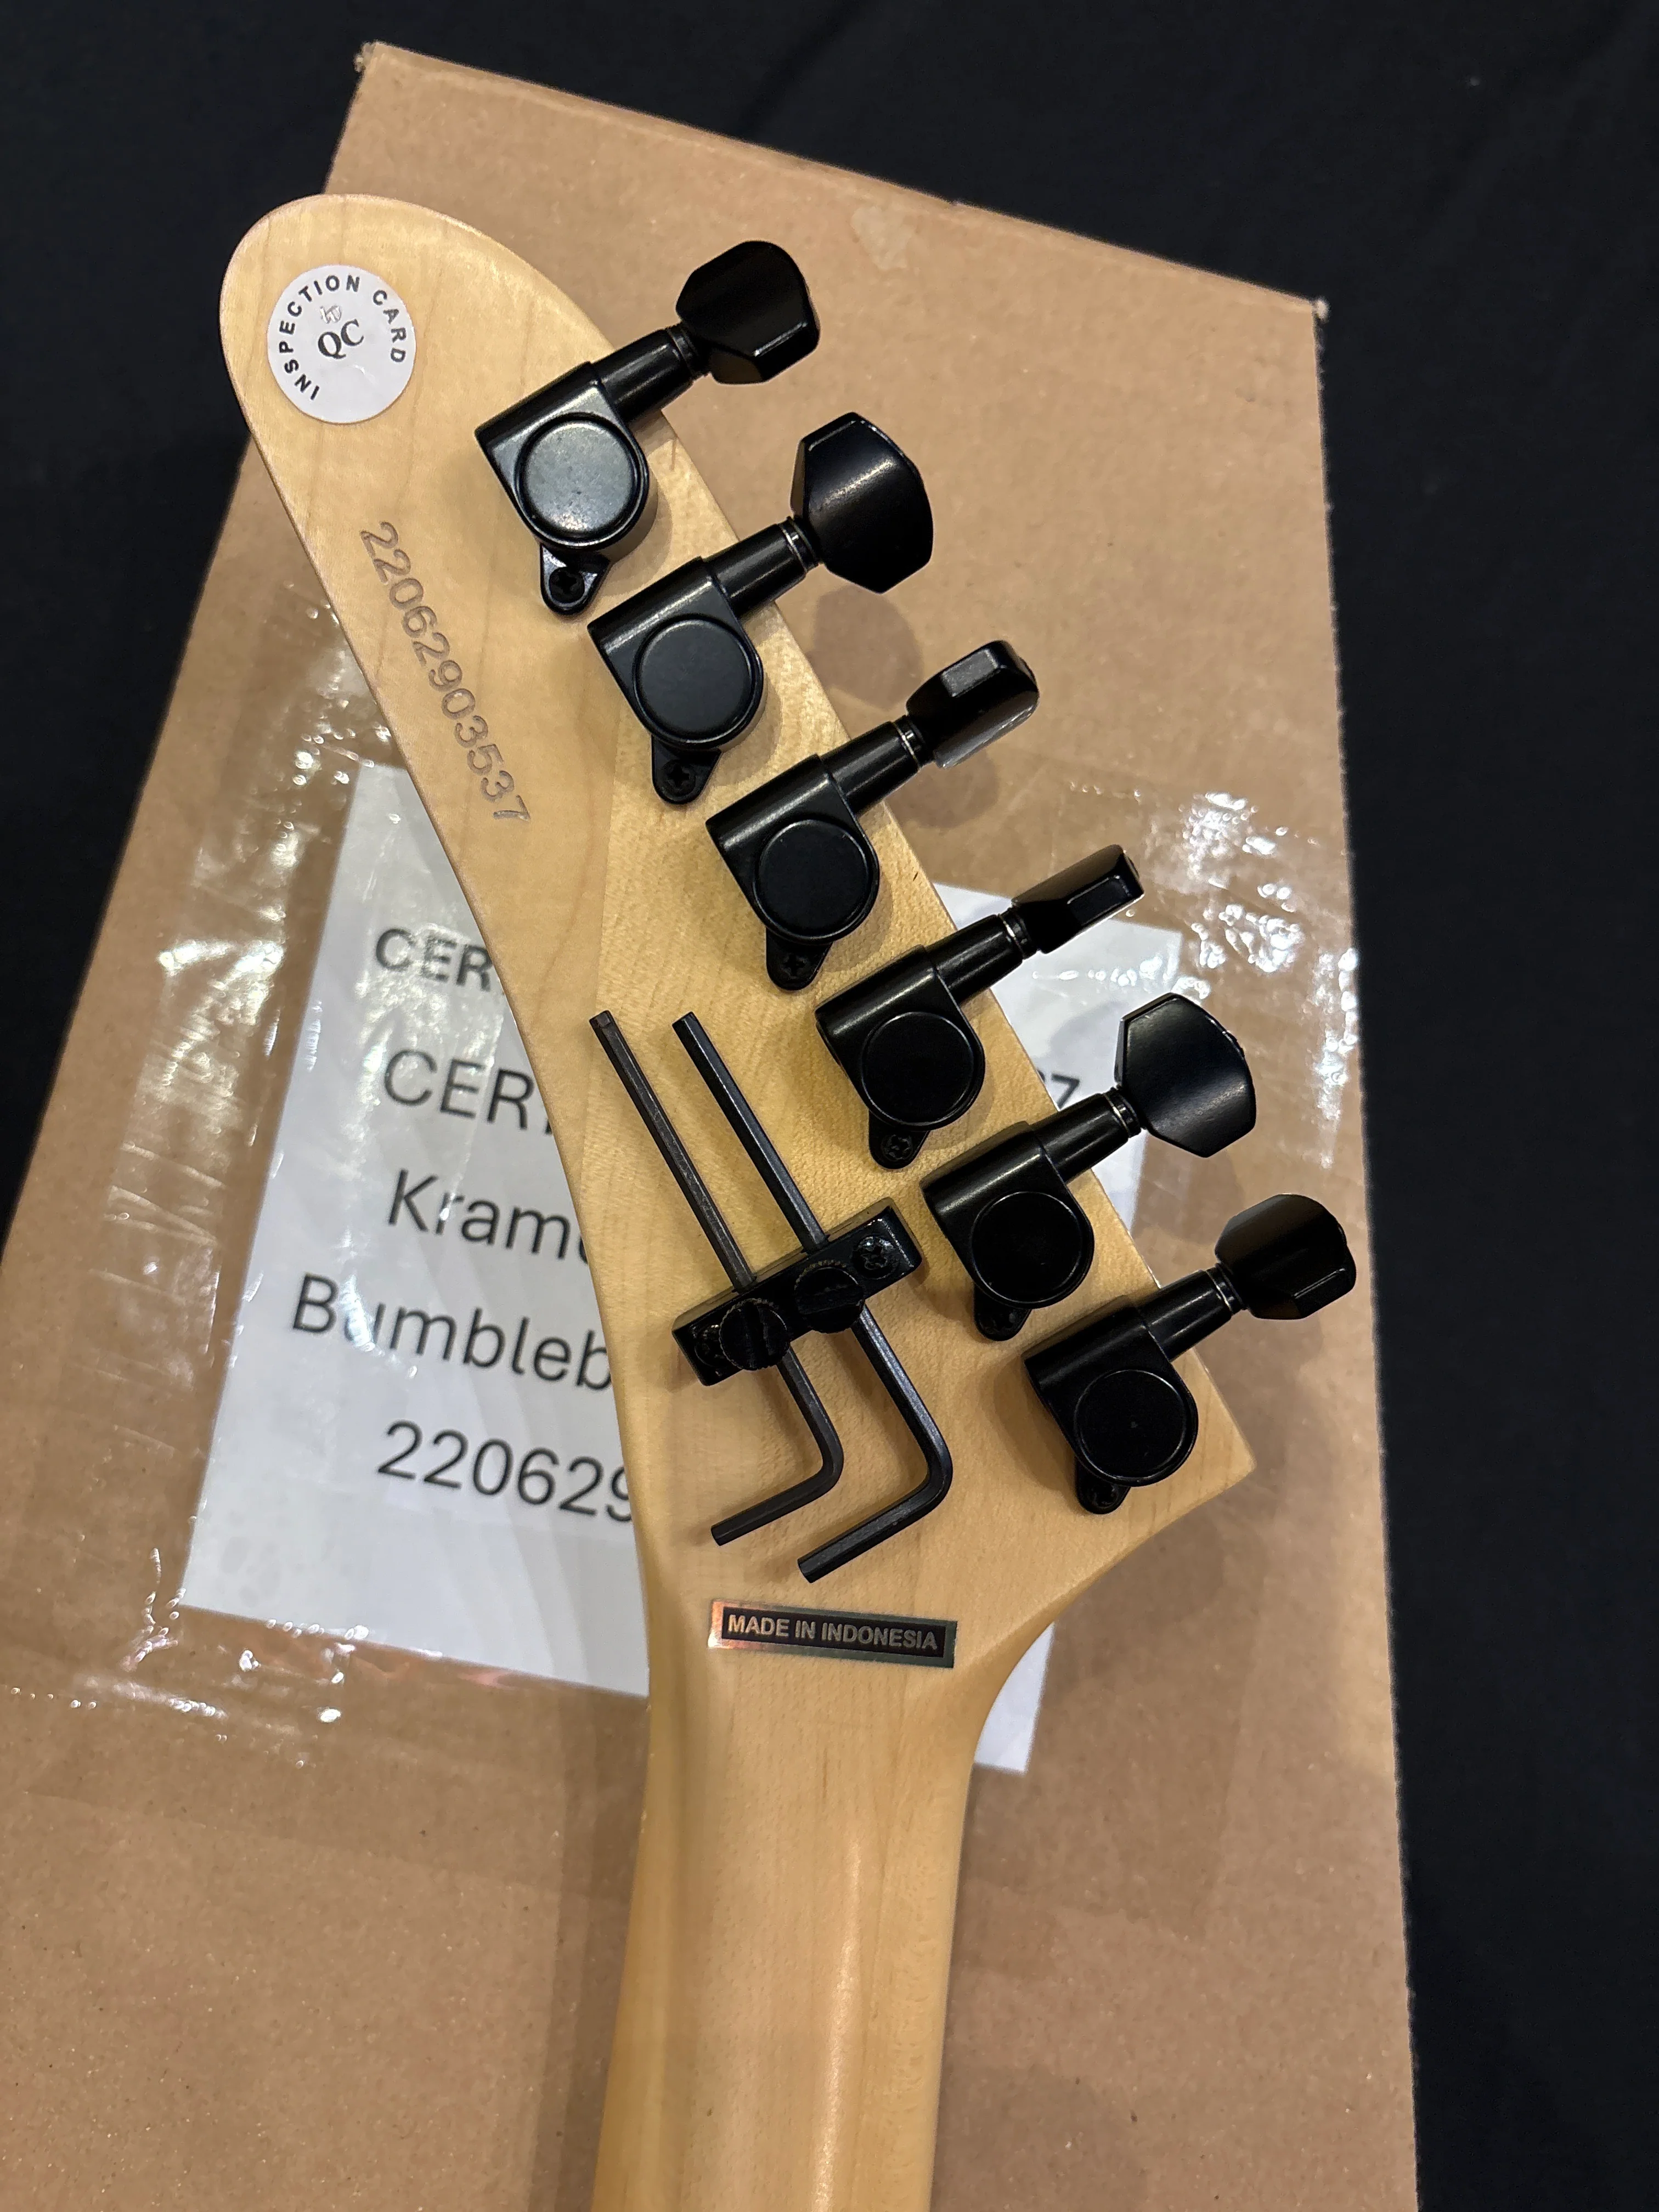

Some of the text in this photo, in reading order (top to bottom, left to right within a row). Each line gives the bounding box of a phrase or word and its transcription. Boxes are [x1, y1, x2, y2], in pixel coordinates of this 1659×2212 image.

[279, 275, 407, 400] INSPECTION CARD
[318, 319, 365, 360] QC
[360, 521, 531, 822] 22062903537
[384, 1048, 552, 1136] CER
[388, 1169, 589, 1264] Kram
[727, 1614, 938, 1650] MADE IN INDONESIA
